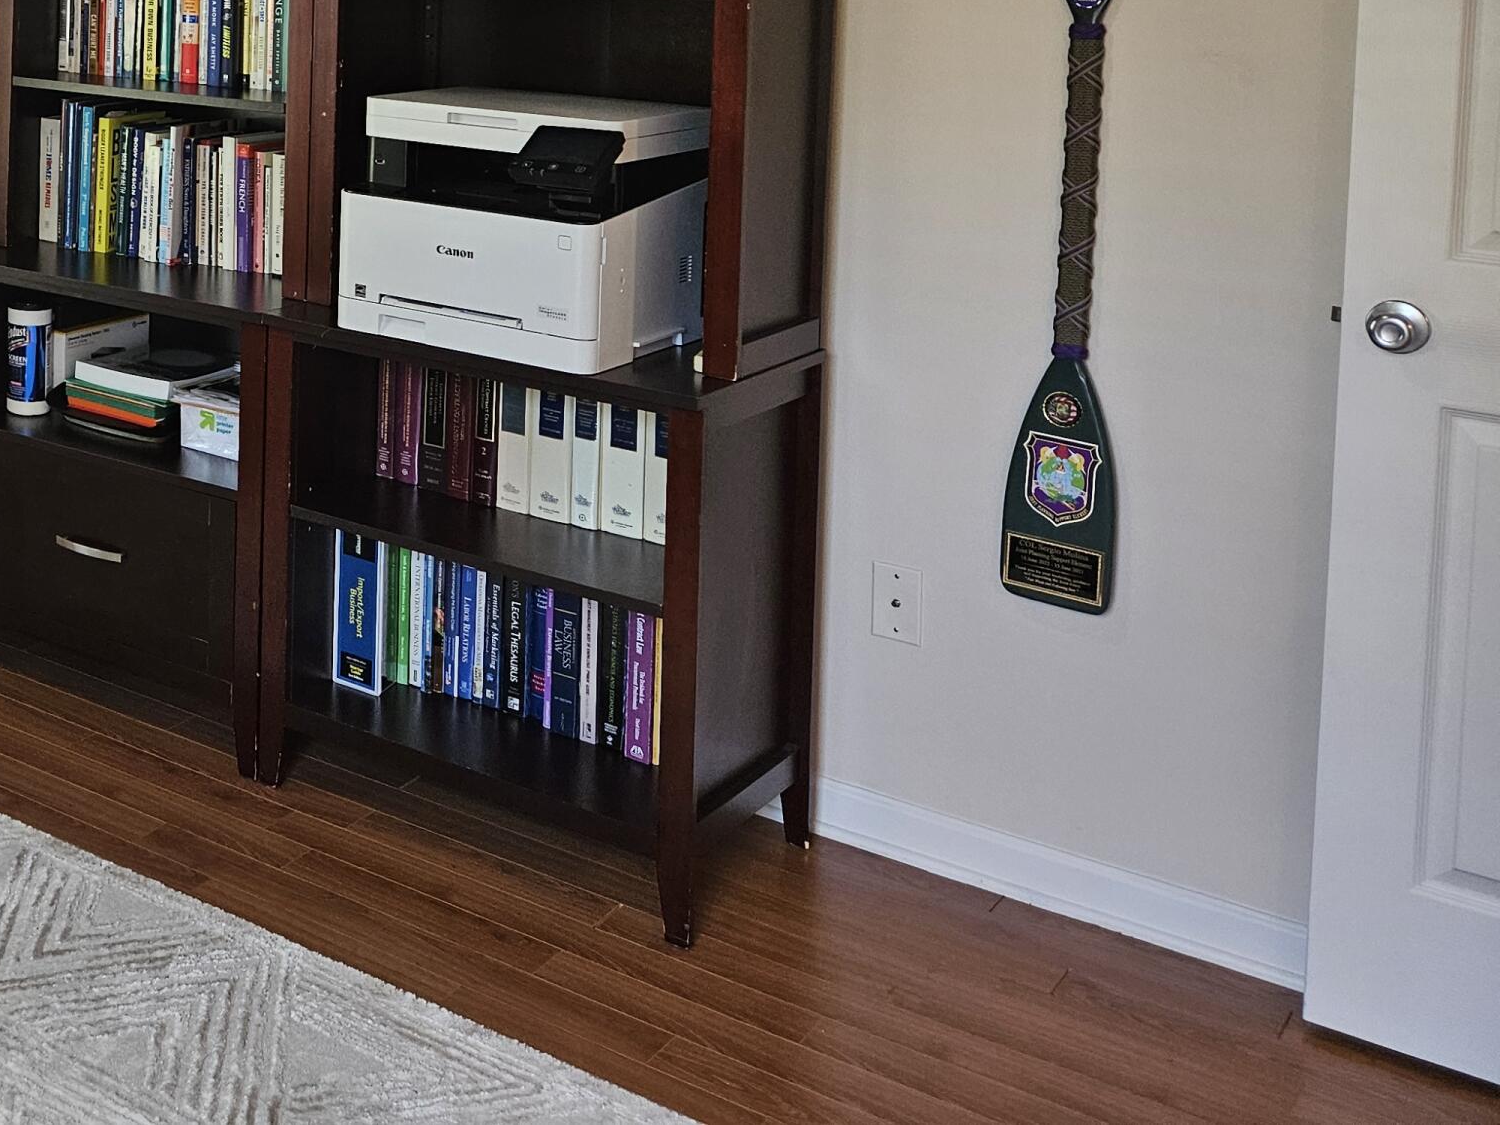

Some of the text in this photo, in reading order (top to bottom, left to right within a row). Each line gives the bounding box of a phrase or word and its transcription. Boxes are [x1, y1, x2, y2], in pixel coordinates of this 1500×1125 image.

[90, 50, 96, 59] ME
[222, 24, 231, 59] LIMITLESS
[119, 152, 128, 194] MEN'S HEALTH
[238, 178, 246, 213] FRENCH
[436, 244, 474, 259] Canon
[216, 421, 234, 429] printer
[1037, 504, 1055, 520] PLANNING
[1015, 546, 1092, 569] Joint Planning Support Element
[1018, 539, 1089, 562] COL Sergio Molina
[349, 588, 358, 625] Business
[356, 577, 365, 638] Import/Export
[412, 564, 421, 657] INTERNATIONAL BUSINESS
[491, 584, 500, 621] Essentials
[462, 596, 472, 663] LABOR RELATIONS
[509, 601, 521, 682] LEGAL THESAURUS
[554, 629, 564, 654] LAW
[562, 619, 573, 669] BUSINESS
[636, 617, 645, 641] Contract
[489, 630, 499, 669] Marketing
[636, 642, 645, 655] Law
[608, 689, 616, 723] ECONOMICS
